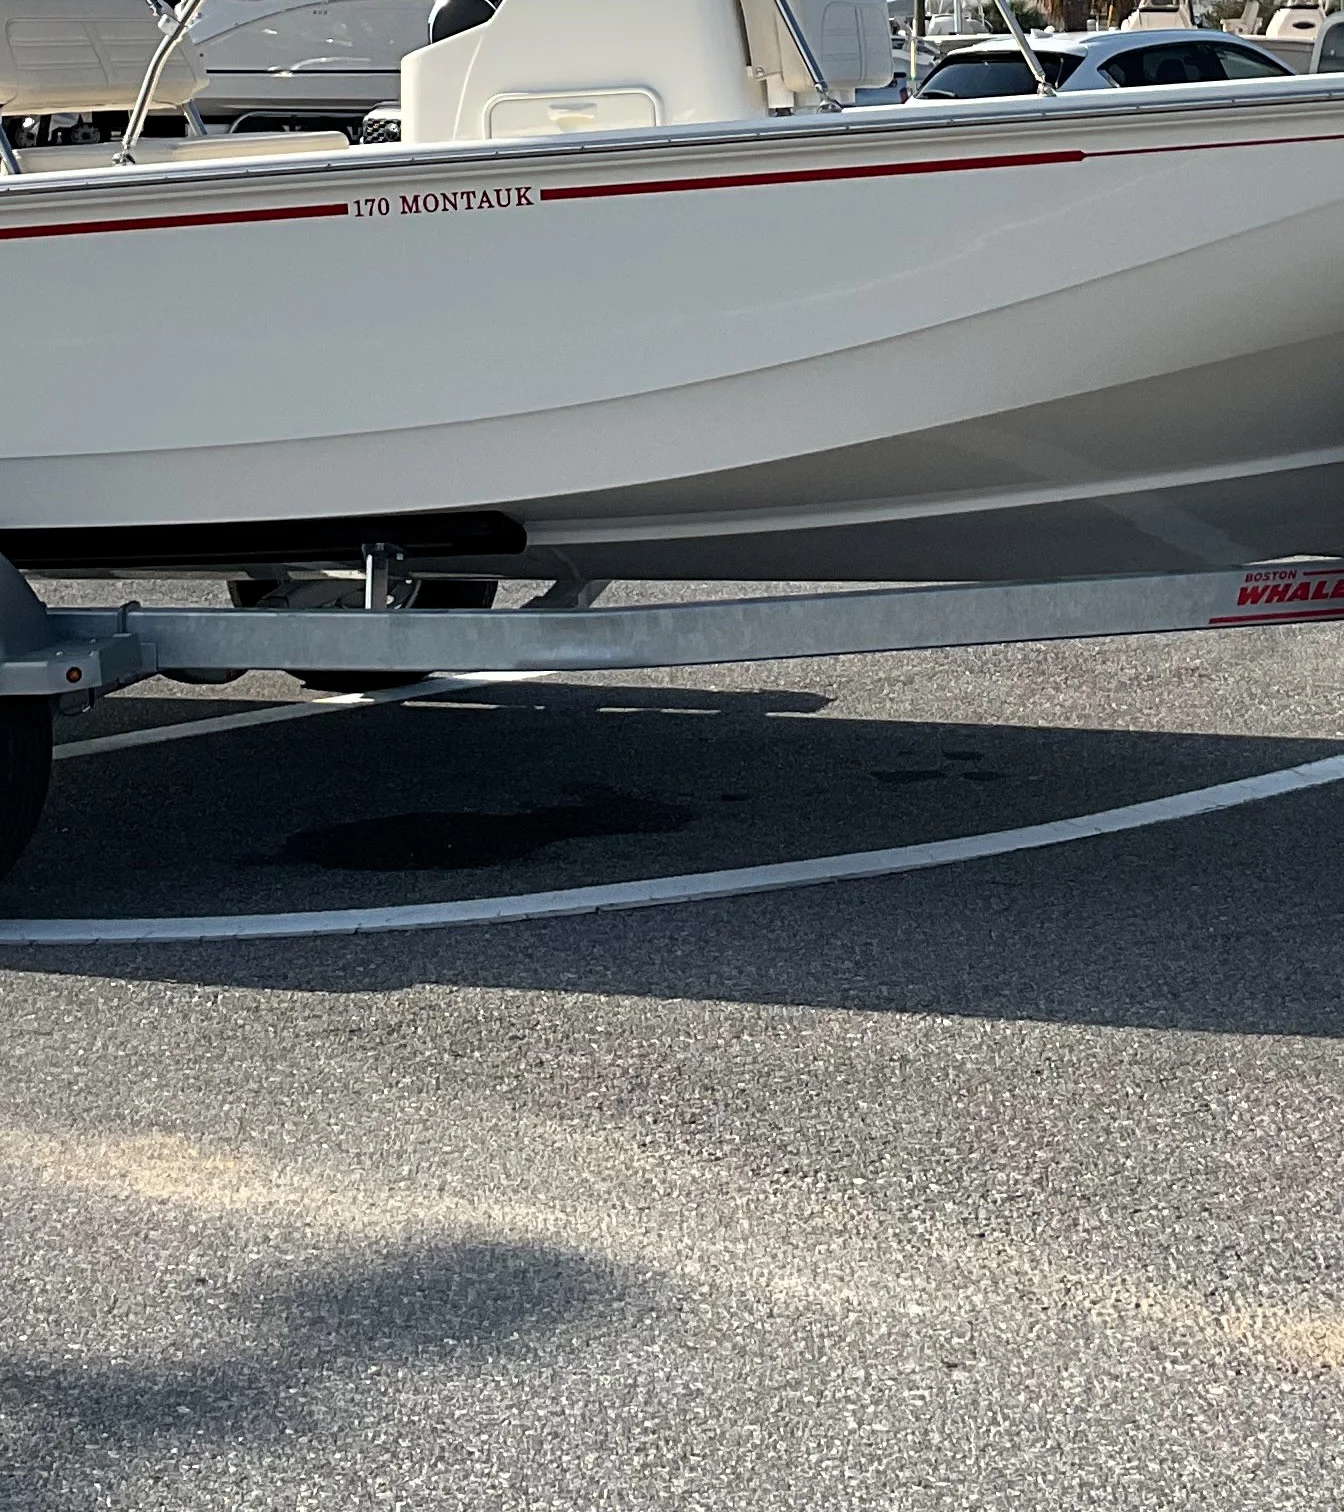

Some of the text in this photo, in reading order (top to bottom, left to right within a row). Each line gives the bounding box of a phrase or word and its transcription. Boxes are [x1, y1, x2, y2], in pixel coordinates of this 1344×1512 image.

[353, 186, 535, 218] 170 MONTAUK
[1244, 569, 1298, 583] BOSTON
